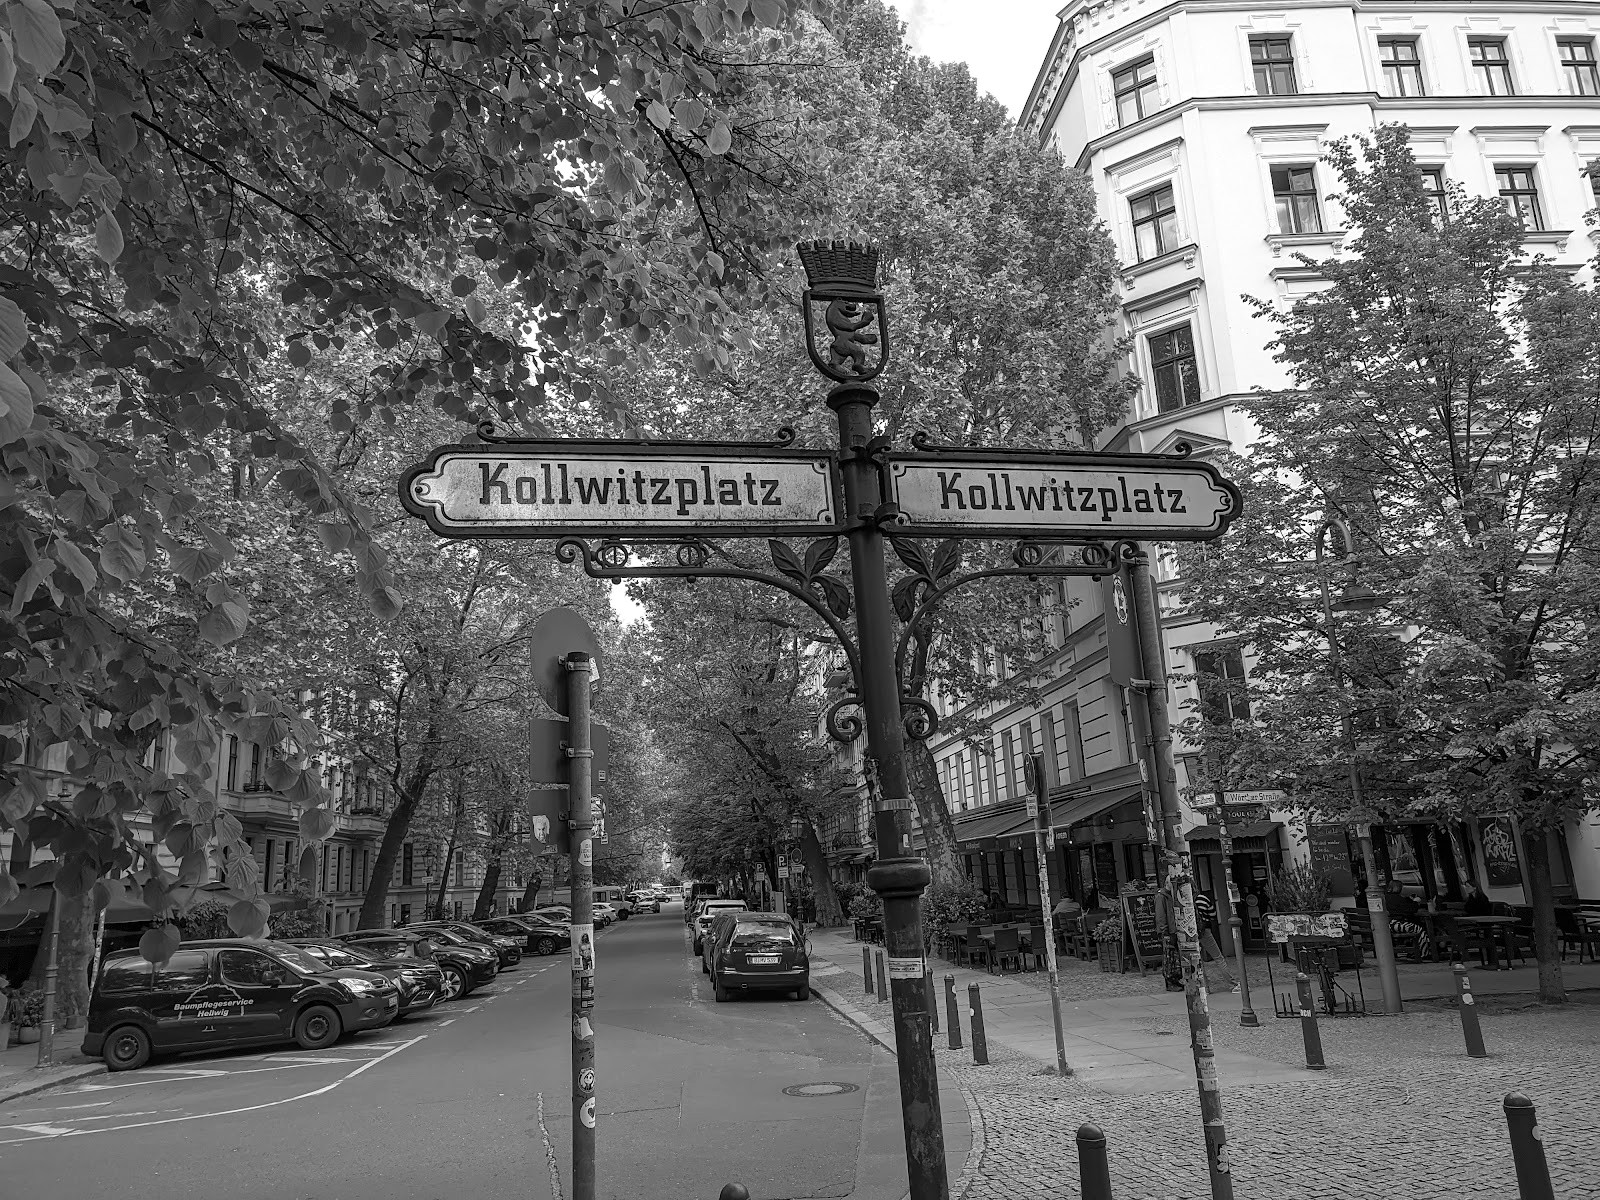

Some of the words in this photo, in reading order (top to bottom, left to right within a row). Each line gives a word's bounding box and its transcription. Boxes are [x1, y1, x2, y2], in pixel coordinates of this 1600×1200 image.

[478, 462, 782, 516] Kollwitzplatz
[936, 471, 1187, 522] Kollwitzplatz
[1230, 793, 1257, 802] Wörter
[779, 856, 784, 866] P
[174, 999, 253, 1011] Baumpflegeservice
[197, 1009, 229, 1017] Hellwig
